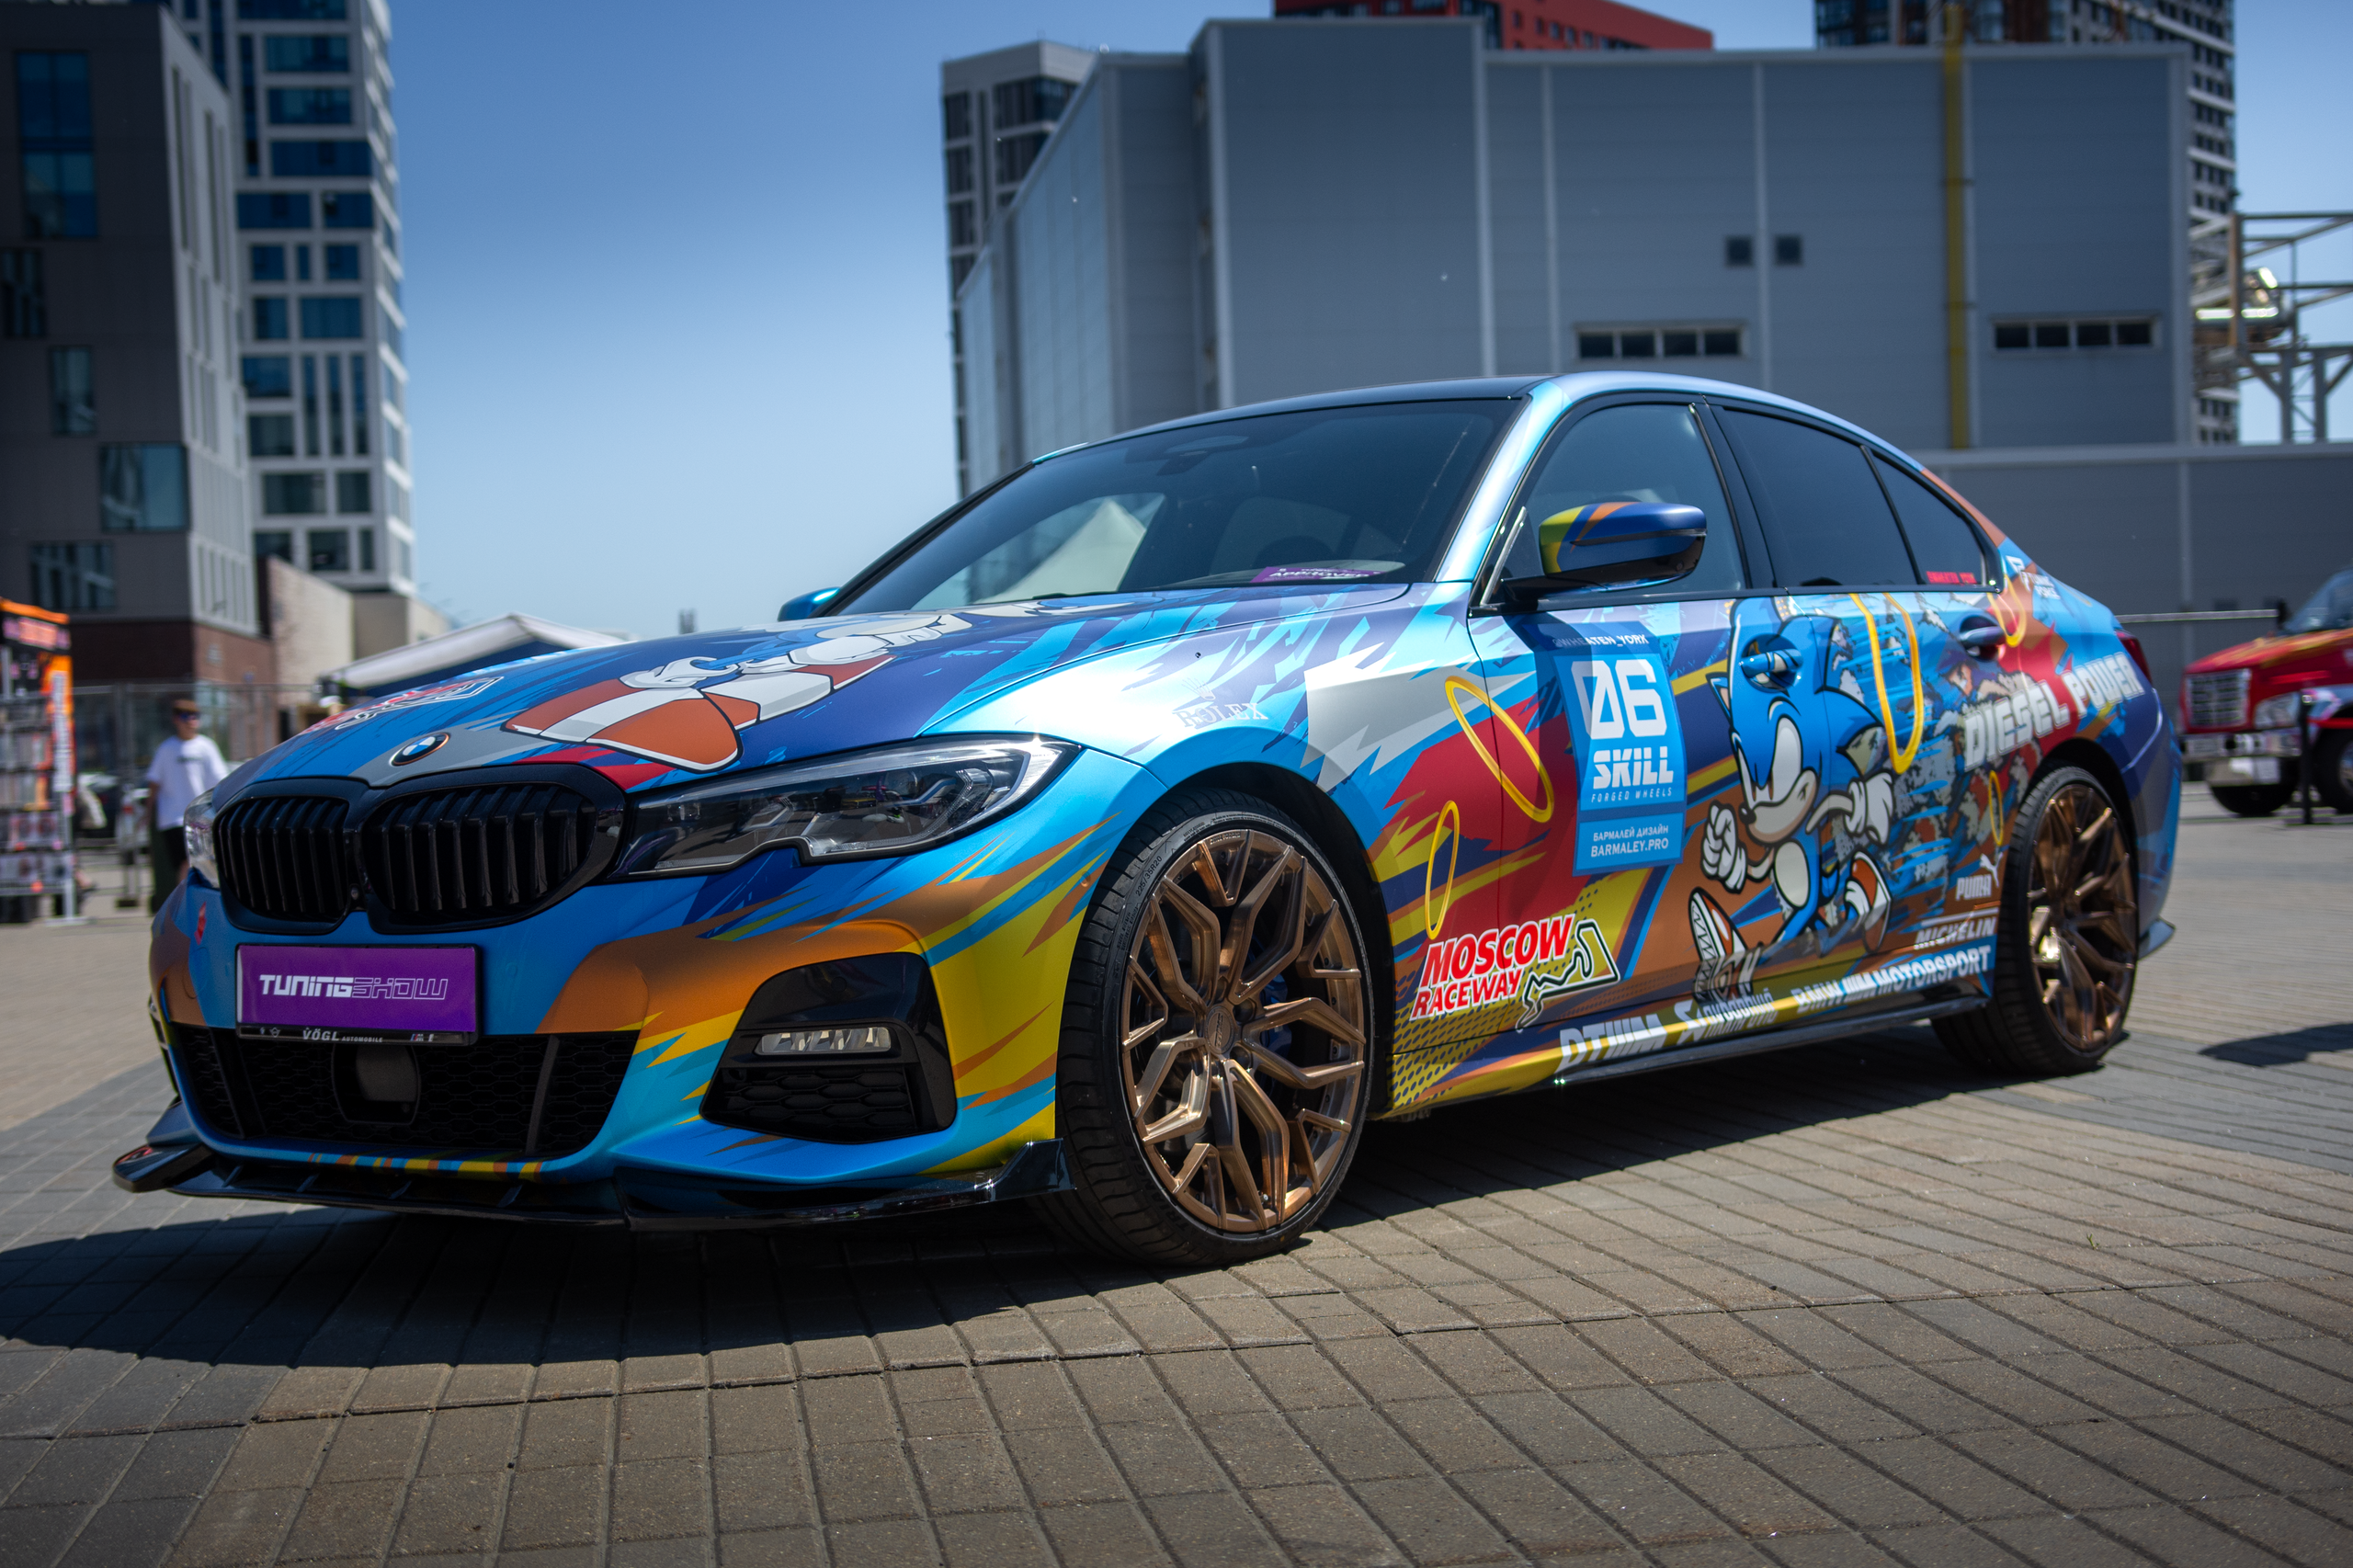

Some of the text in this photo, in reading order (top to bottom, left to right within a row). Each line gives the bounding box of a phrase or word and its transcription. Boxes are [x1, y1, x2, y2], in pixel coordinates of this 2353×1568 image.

[1174, 702, 1268, 728] ROLEX
[1571, 659, 1667, 740] 06
[1963, 652, 2145, 773] DIESEL POWER
[1593, 746, 1674, 790] SKILL
[1591, 787, 1673, 803] FORGED WHEELS
[1591, 837, 1669, 858] BARMALEY.PRO
[1593, 824, 1669, 842] БАРМАЛЕЙ ДИЗАЙН
[1135, 855, 1163, 897] 225/35R20
[1955, 874, 1992, 901] PUMA
[1915, 916, 1997, 944] MICHELIN
[1419, 915, 1574, 989] MOSCOW
[1871, 945, 1992, 995] MOTORSPORT
[1411, 968, 1523, 1020] RACEWAY
[1121, 1133, 1188, 1232] TRIANGLE
